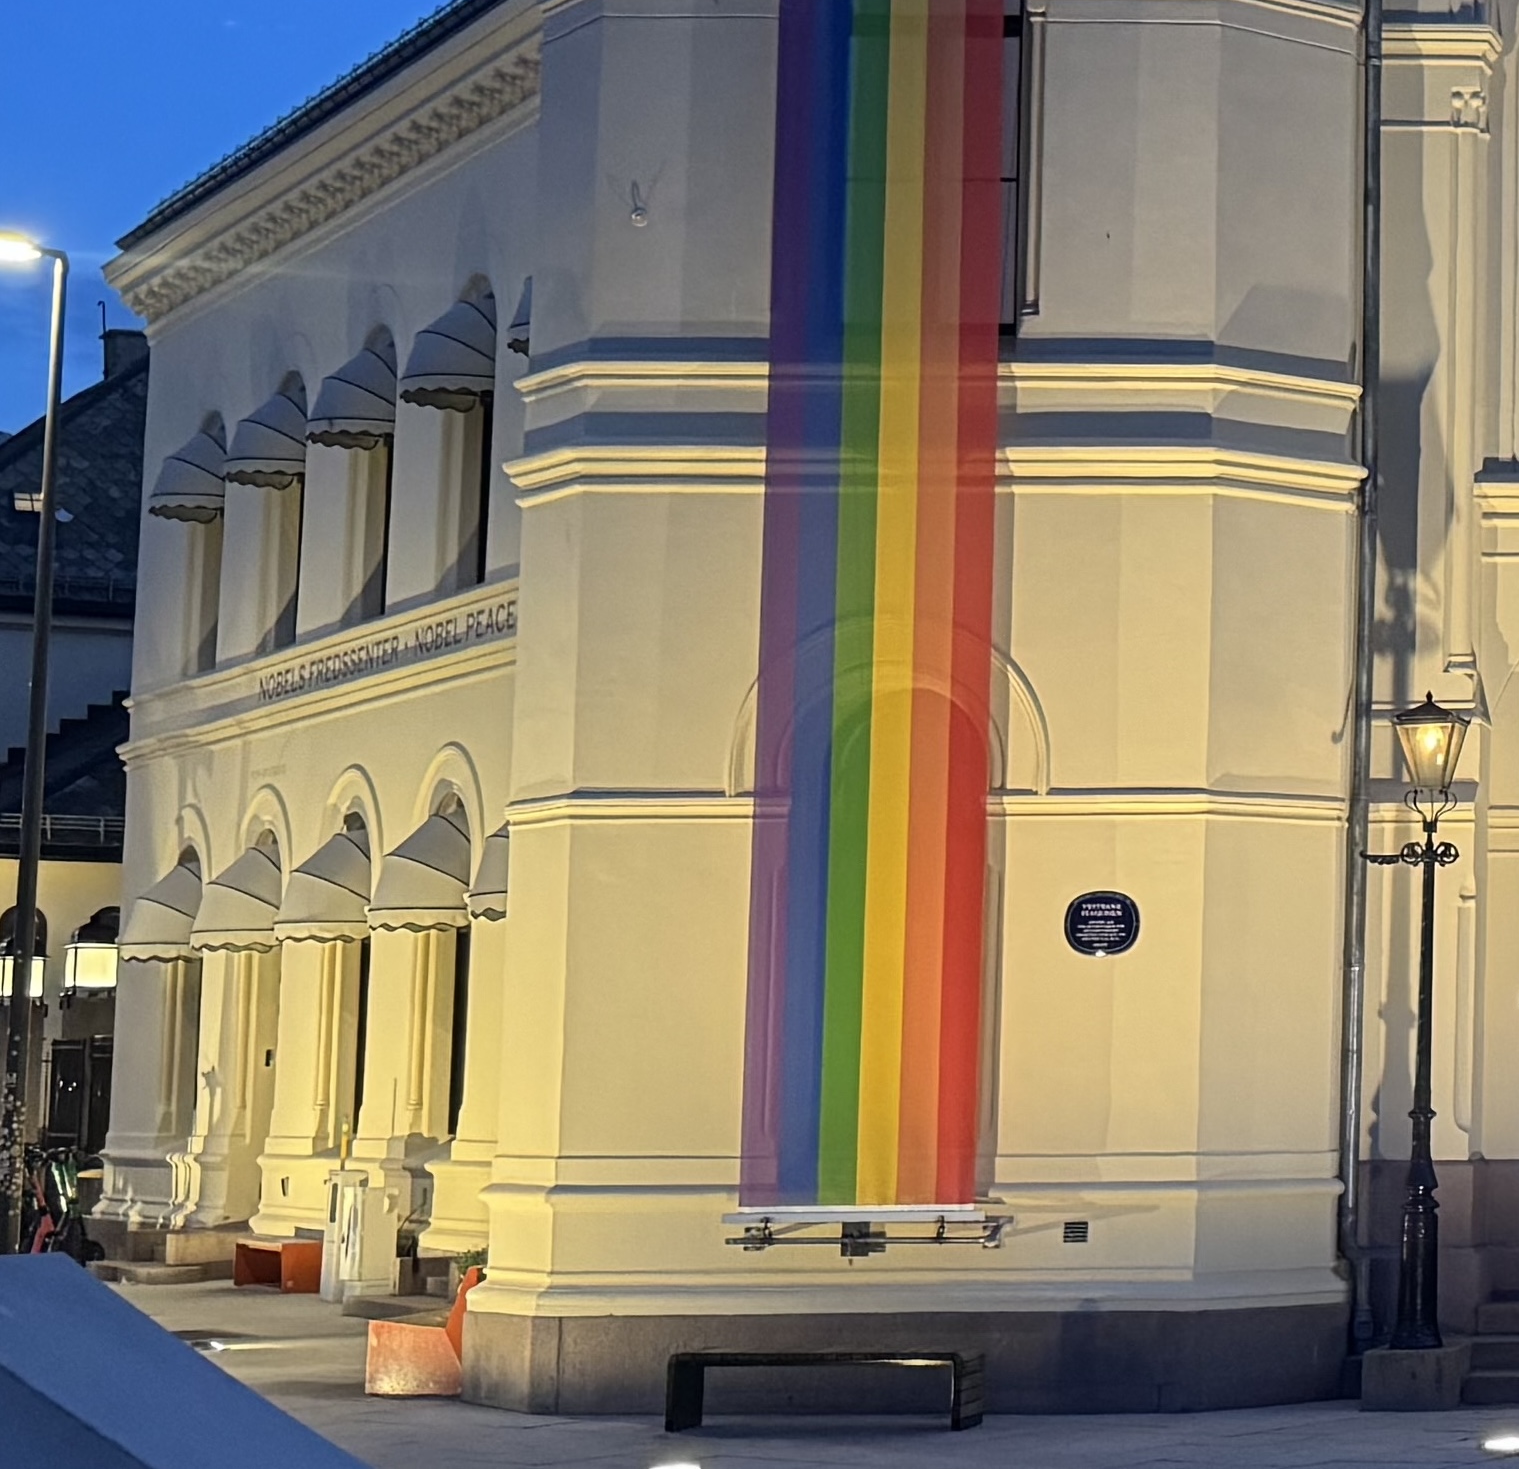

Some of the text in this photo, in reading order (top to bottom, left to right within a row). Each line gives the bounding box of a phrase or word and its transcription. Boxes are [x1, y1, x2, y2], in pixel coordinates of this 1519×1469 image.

[259, 600, 517, 701] NOBELS FREDSSENTER NOBEL PEACE
